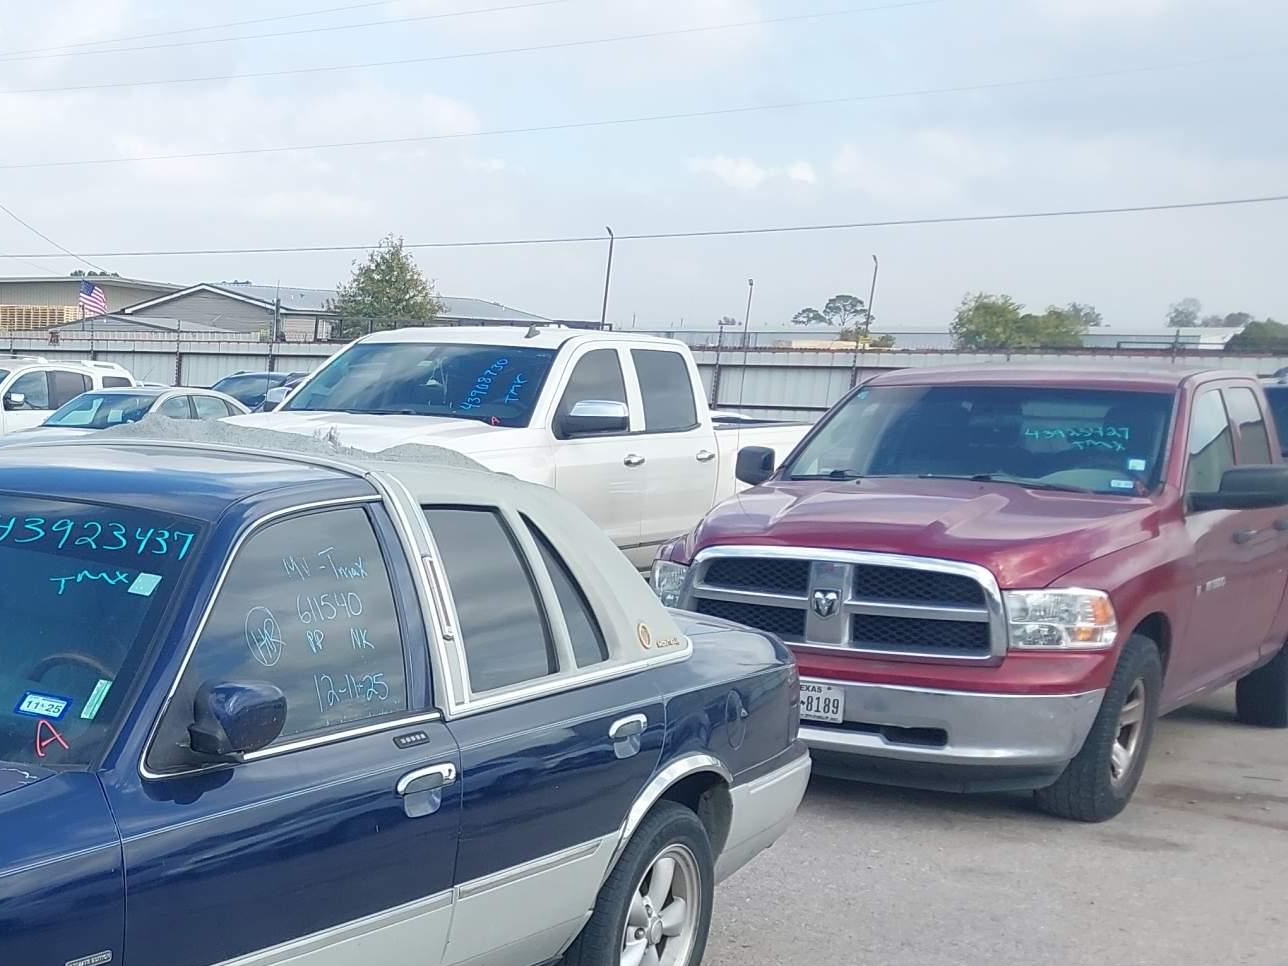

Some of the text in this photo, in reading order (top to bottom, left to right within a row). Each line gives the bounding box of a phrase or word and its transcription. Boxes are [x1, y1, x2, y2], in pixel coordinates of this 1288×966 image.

[296, 592, 363, 624] 611540
[800, 684, 823, 693] EXAS
[35, 719, 69, 757] A
